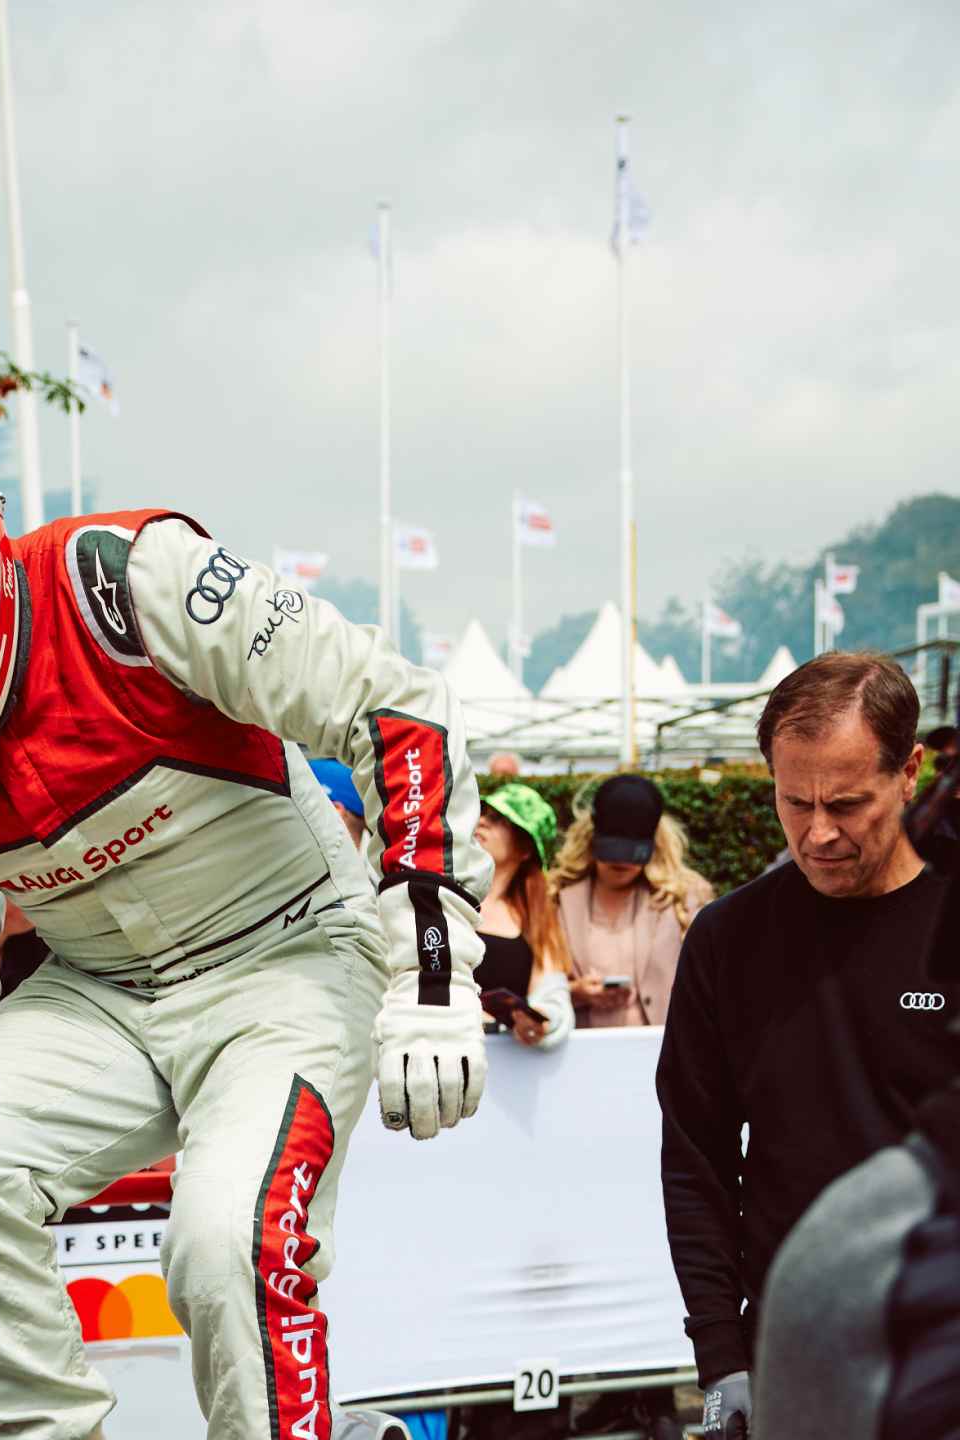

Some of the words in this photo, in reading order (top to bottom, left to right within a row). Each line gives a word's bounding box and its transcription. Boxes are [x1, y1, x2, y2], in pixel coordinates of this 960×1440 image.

[404, 747, 424, 813] Sport
[83, 803, 173, 873] Sport
[399, 814, 420, 870] Audi
[95, 1231, 163, 1250] SPEE
[268, 1160, 314, 1300] Sport
[521, 1369, 554, 1400] 20
